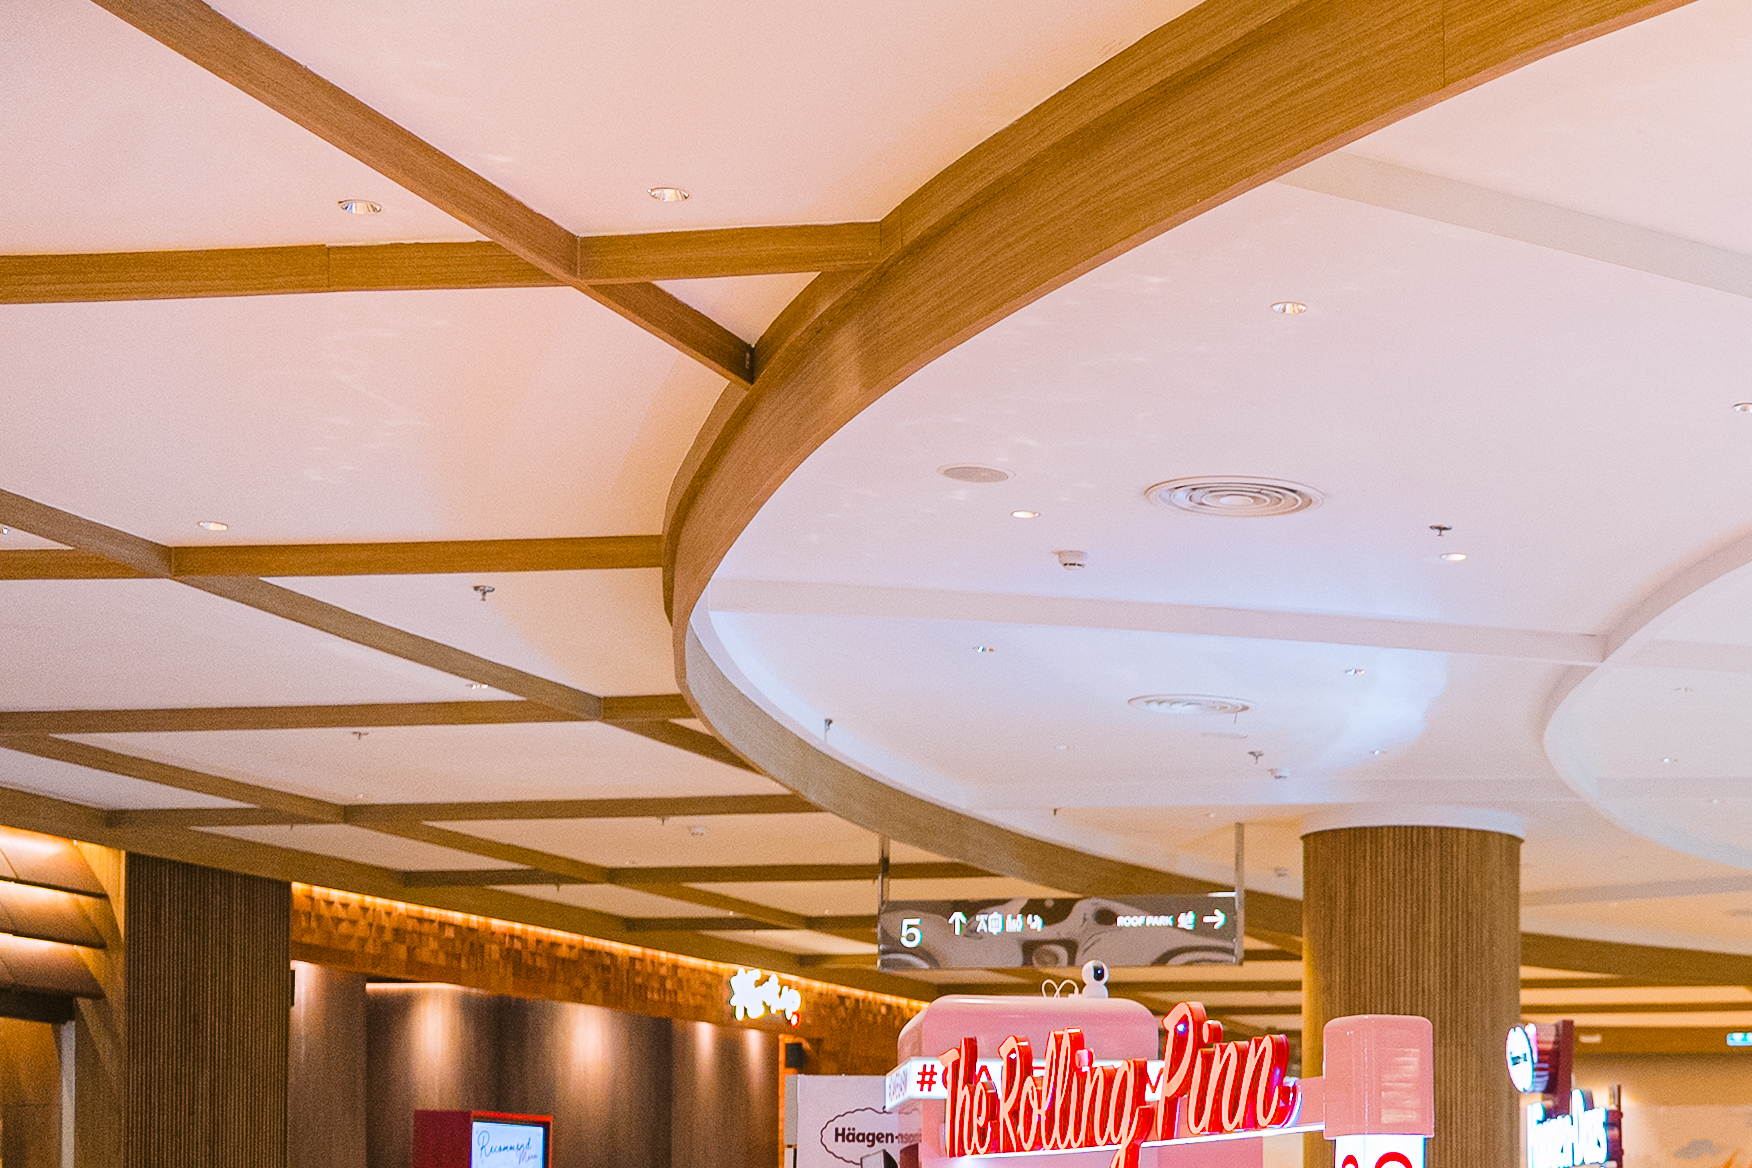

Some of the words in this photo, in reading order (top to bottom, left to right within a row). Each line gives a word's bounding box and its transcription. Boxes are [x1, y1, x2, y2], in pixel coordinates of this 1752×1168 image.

[900, 918, 922, 948] 5
[1116, 915, 1145, 927] ROOF
[1146, 915, 1173, 926] PARK
[937, 1036, 996, 1158] The
[1157, 1001, 1290, 1140] Pinn
[478, 1130, 531, 1158] Recommend
